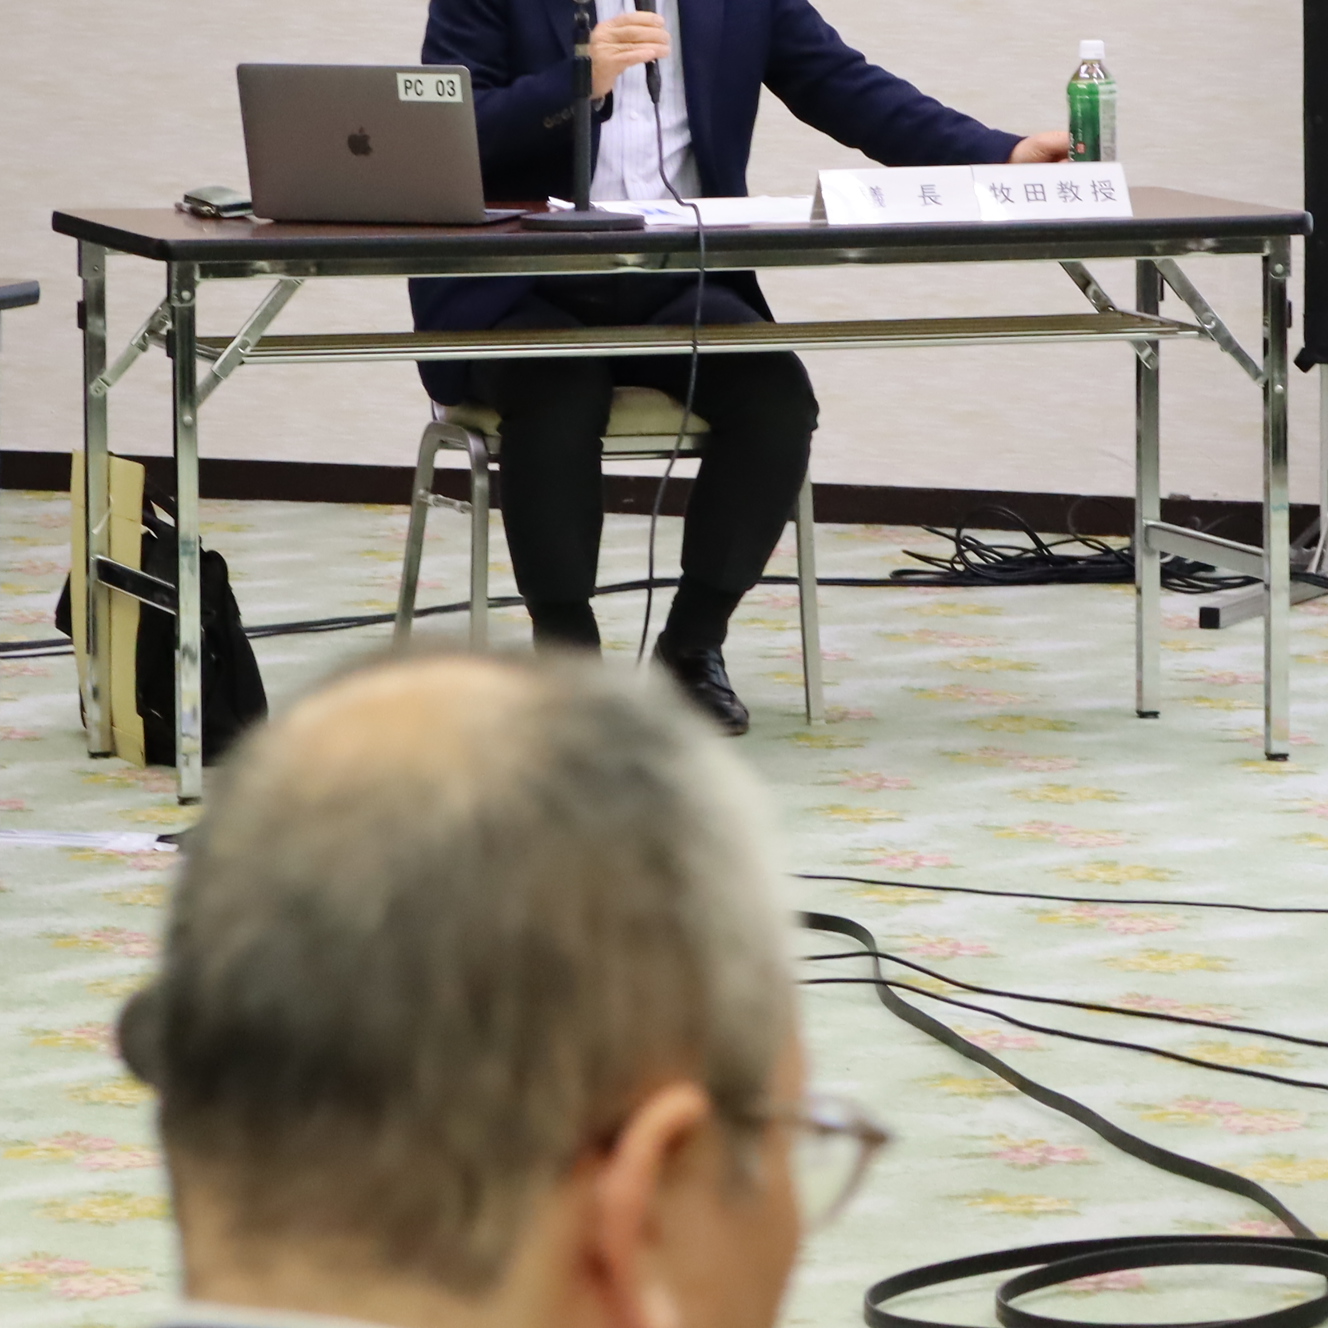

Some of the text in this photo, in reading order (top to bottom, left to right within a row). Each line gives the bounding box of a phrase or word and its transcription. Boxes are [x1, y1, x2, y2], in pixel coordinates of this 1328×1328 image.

[404, 79, 456, 97] PC 03
[990, 179, 1118, 205] 牧田教授
